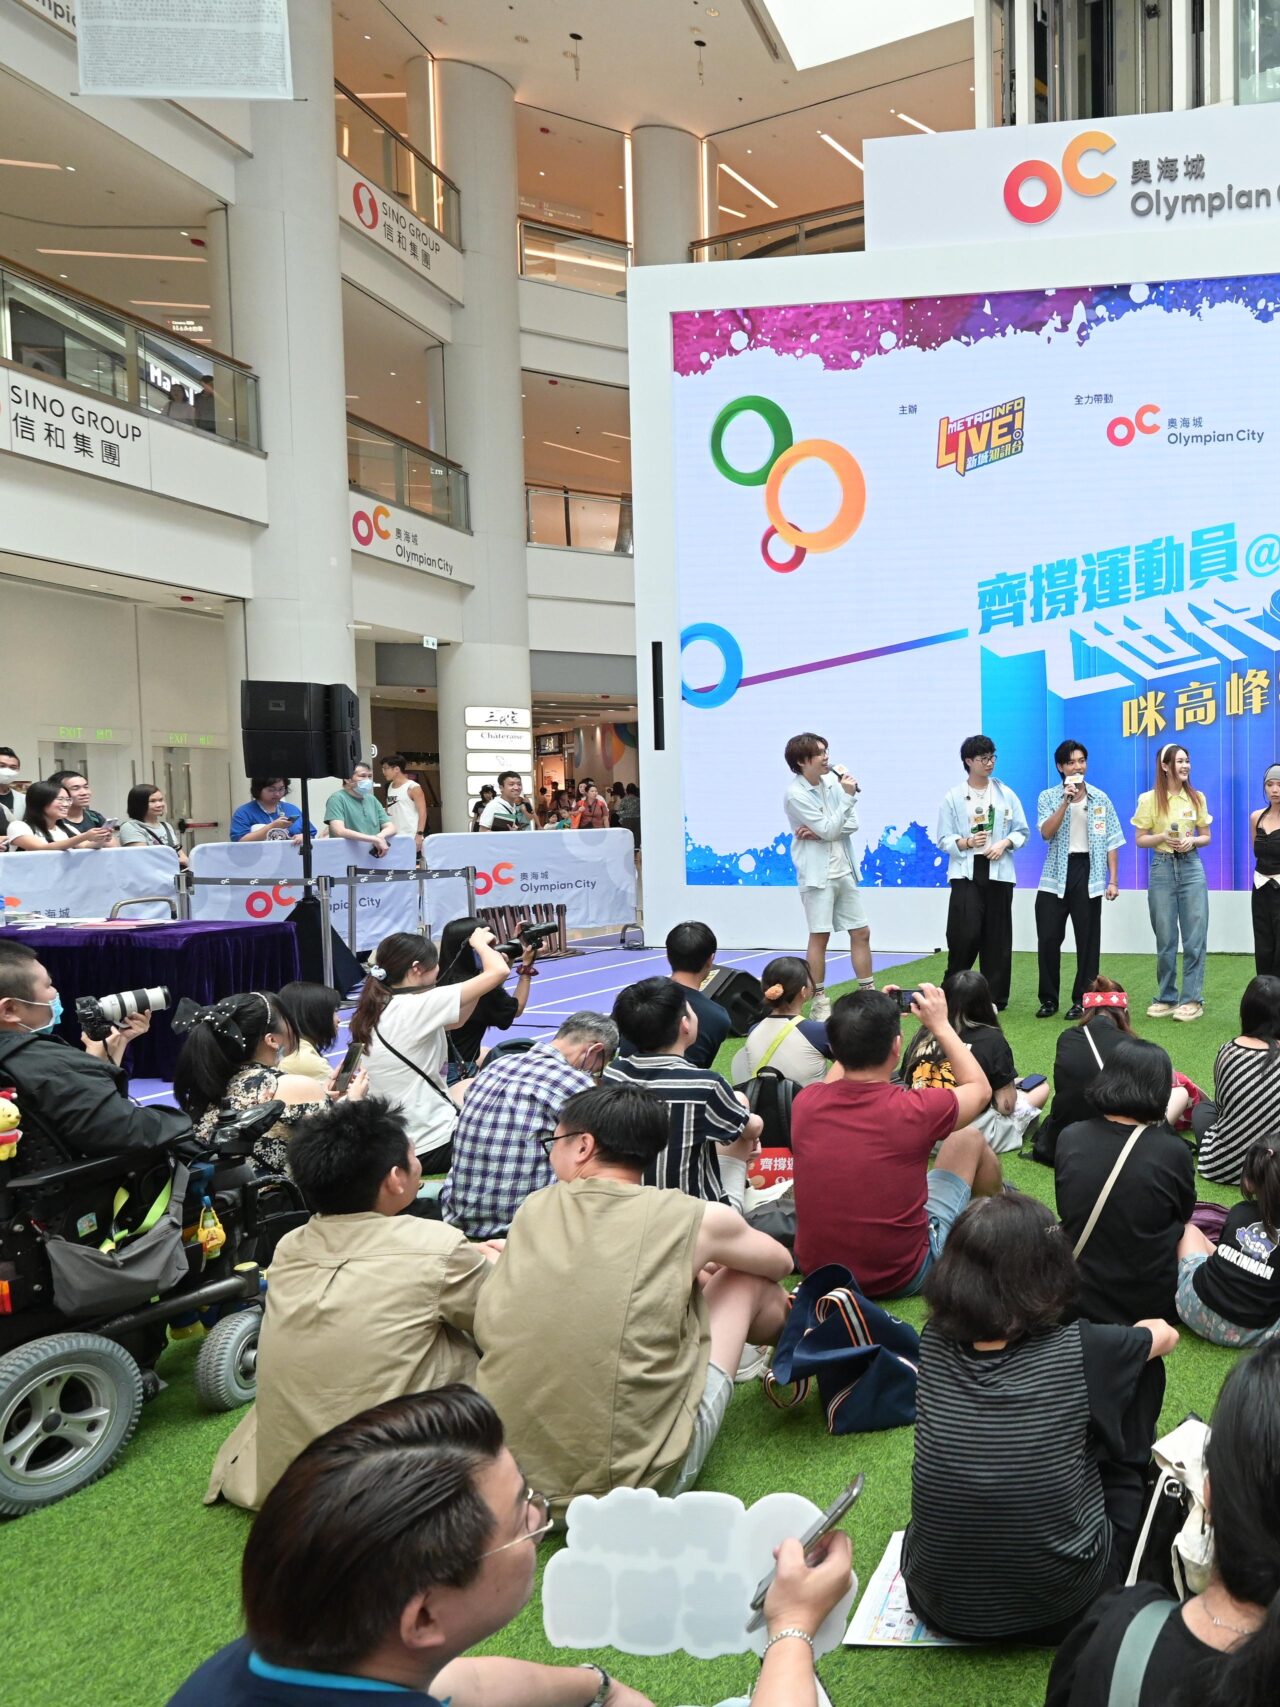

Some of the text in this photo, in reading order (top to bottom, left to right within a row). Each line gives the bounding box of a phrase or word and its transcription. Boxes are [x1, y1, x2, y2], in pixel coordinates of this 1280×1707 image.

[1130, 154, 1206, 185] 奧海城
[1130, 184, 1271, 220] Olympian
[382, 202, 441, 255] SINO GROUP
[383, 222, 431, 270] 信和集團
[1074, 394, 1113, 405] 全力帶動
[10, 385, 142, 442] SINO GROUP
[899, 404, 917, 415] 主辦
[1167, 417, 1203, 430] 奧海城
[12, 412, 120, 468] 信和集團
[1167, 429, 1265, 447] Olympian City
[395, 544, 454, 576] Olympian City
[59, 727, 83, 739] EXIT
[169, 734, 188, 745] EXIT
[520, 879, 597, 893] Olympian City
[358, 897, 381, 908] City
